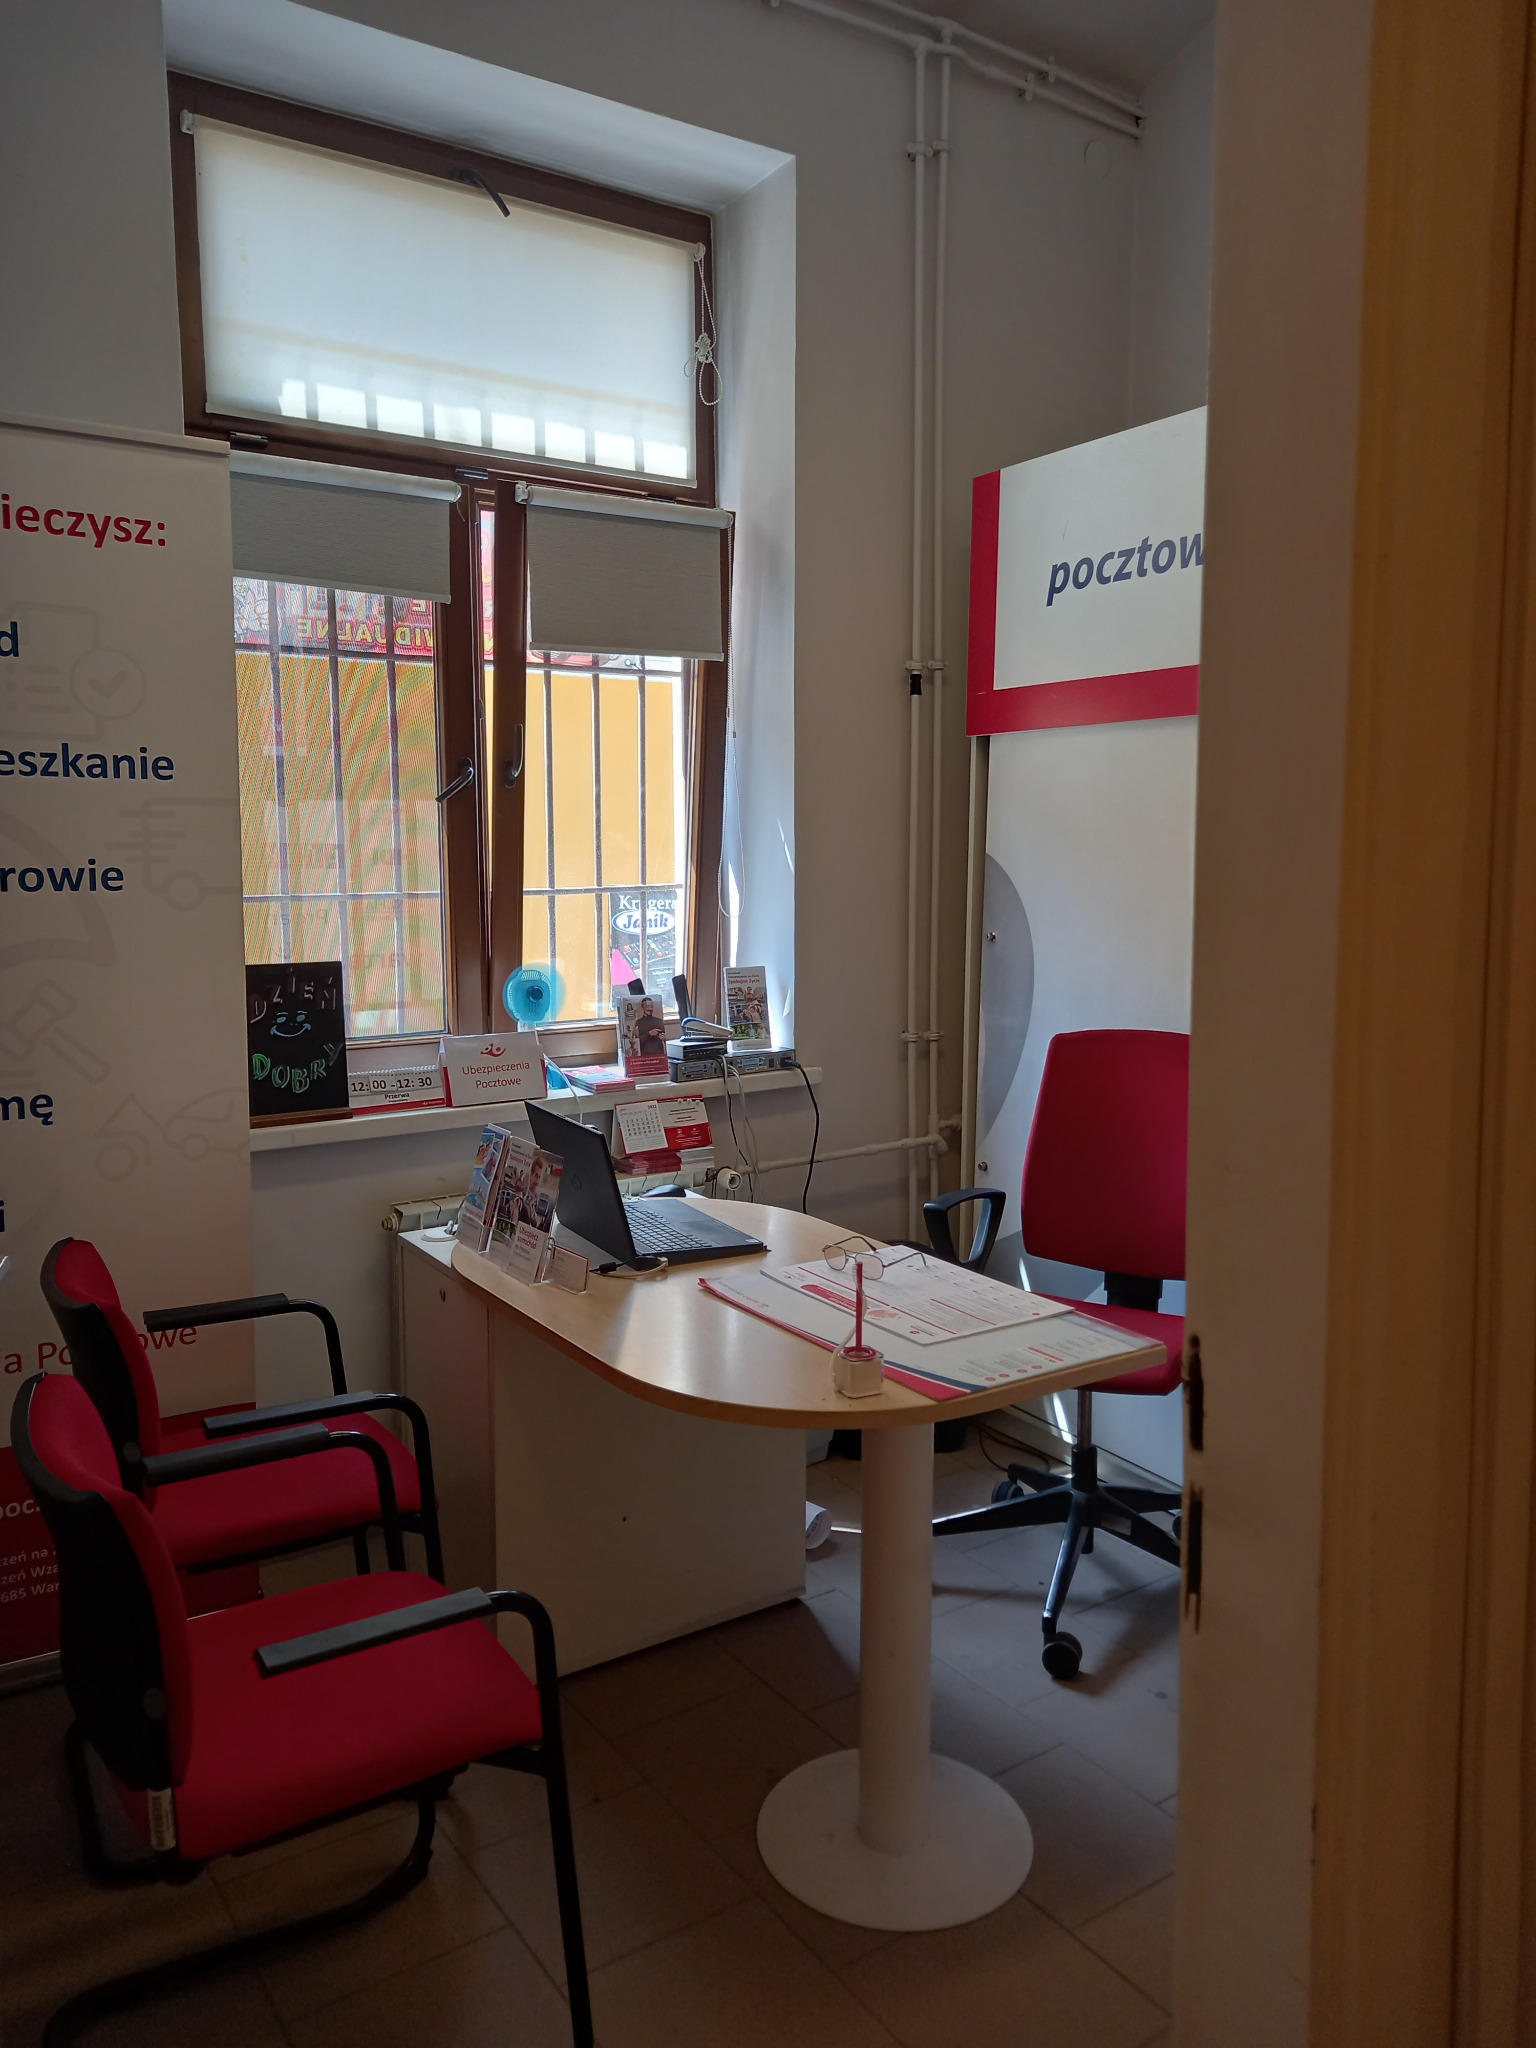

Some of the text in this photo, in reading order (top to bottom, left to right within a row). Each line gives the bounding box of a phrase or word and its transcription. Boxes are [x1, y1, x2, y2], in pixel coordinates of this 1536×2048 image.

[1, 493, 166, 548] ieczysz:
[0, 743, 174, 781] eszkanie
[0, 858, 124, 893] rowie
[252, 1042, 344, 1094] DOBRY
[462, 1062, 531, 1076] Ubezpieczenia
[475, 1077, 522, 1089] Pocztowe
[384, 1092, 410, 1101] Przerwa
